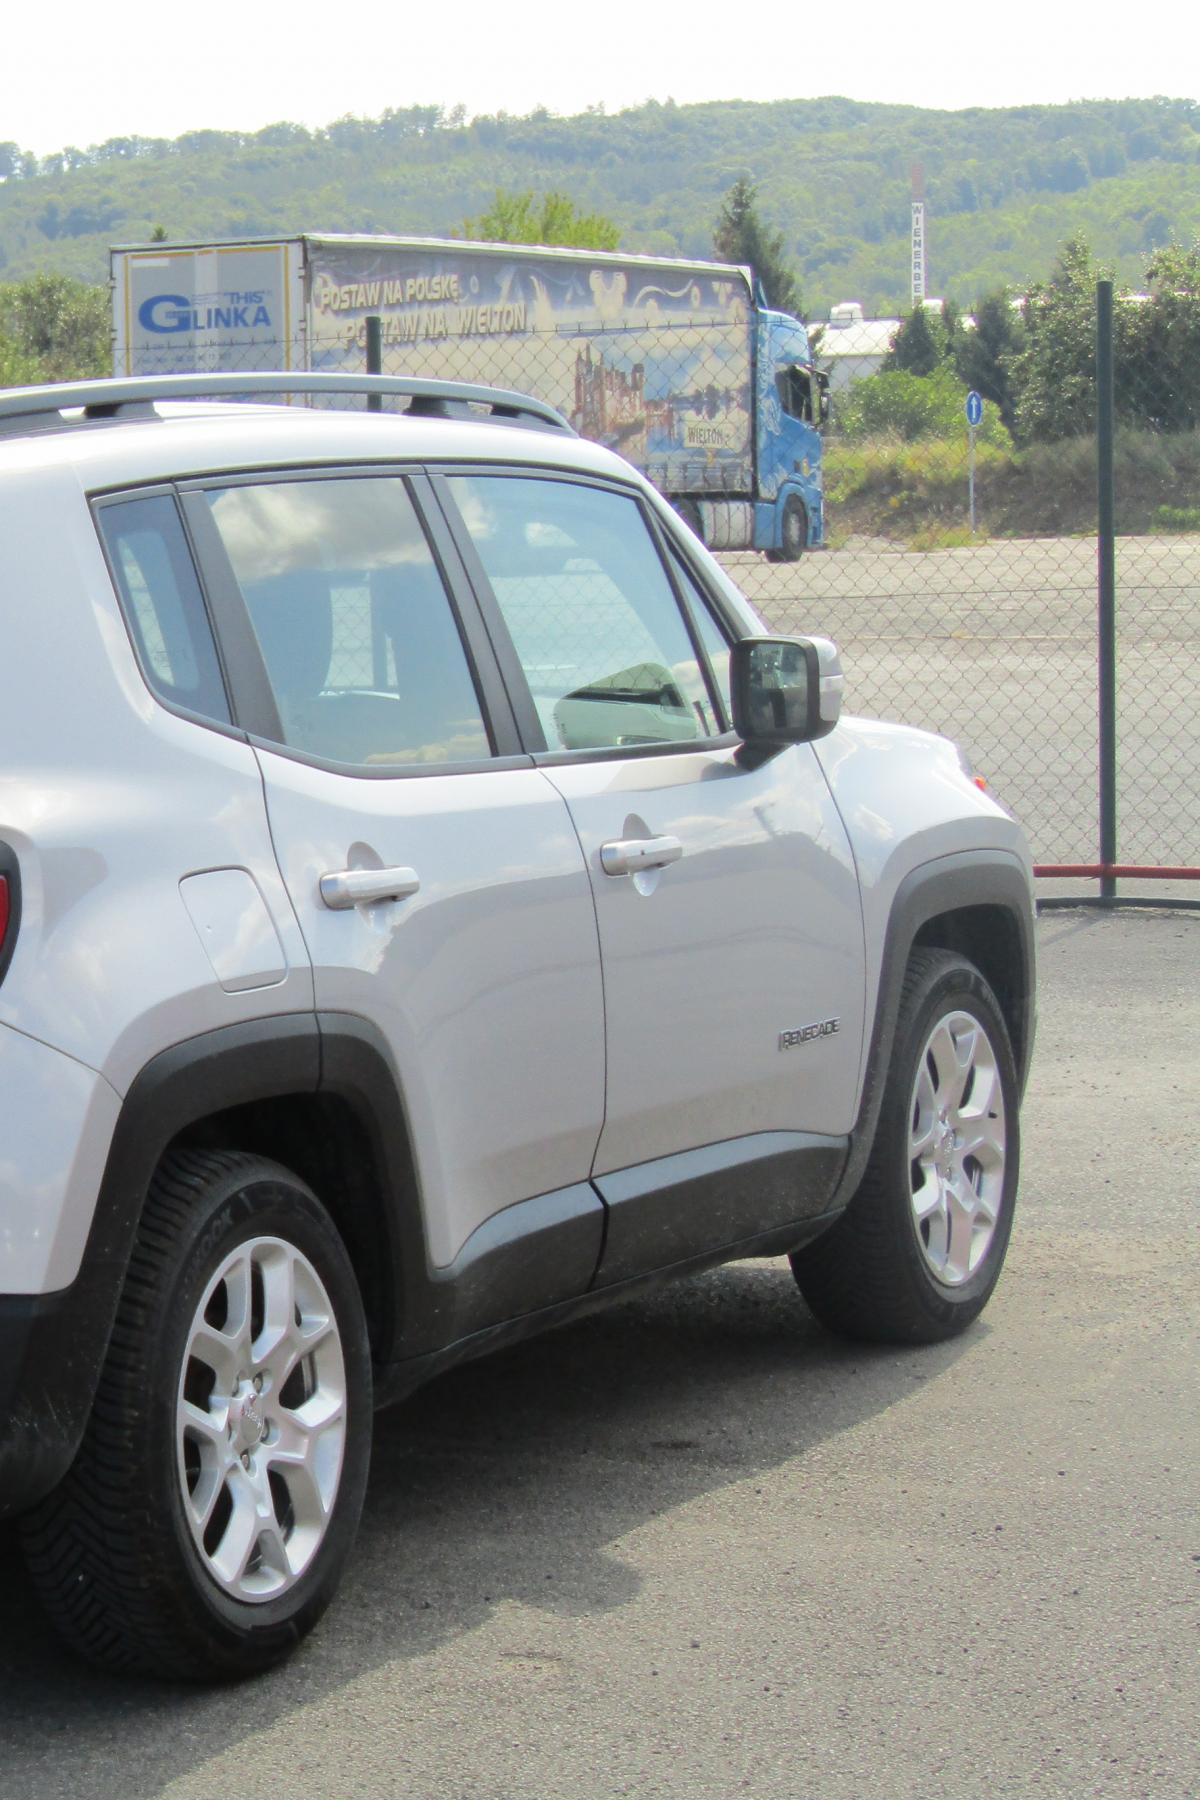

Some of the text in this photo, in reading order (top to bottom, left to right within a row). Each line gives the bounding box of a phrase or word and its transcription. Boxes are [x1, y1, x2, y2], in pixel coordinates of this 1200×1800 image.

[138, 294, 272, 334] GLINKA
[320, 280, 381, 314] POSTAW
[383, 277, 403, 305] NA
[345, 313, 419, 349] POTAW
[458, 303, 527, 336] WIELTON
[780, 1017, 841, 1050] RENEGADE
